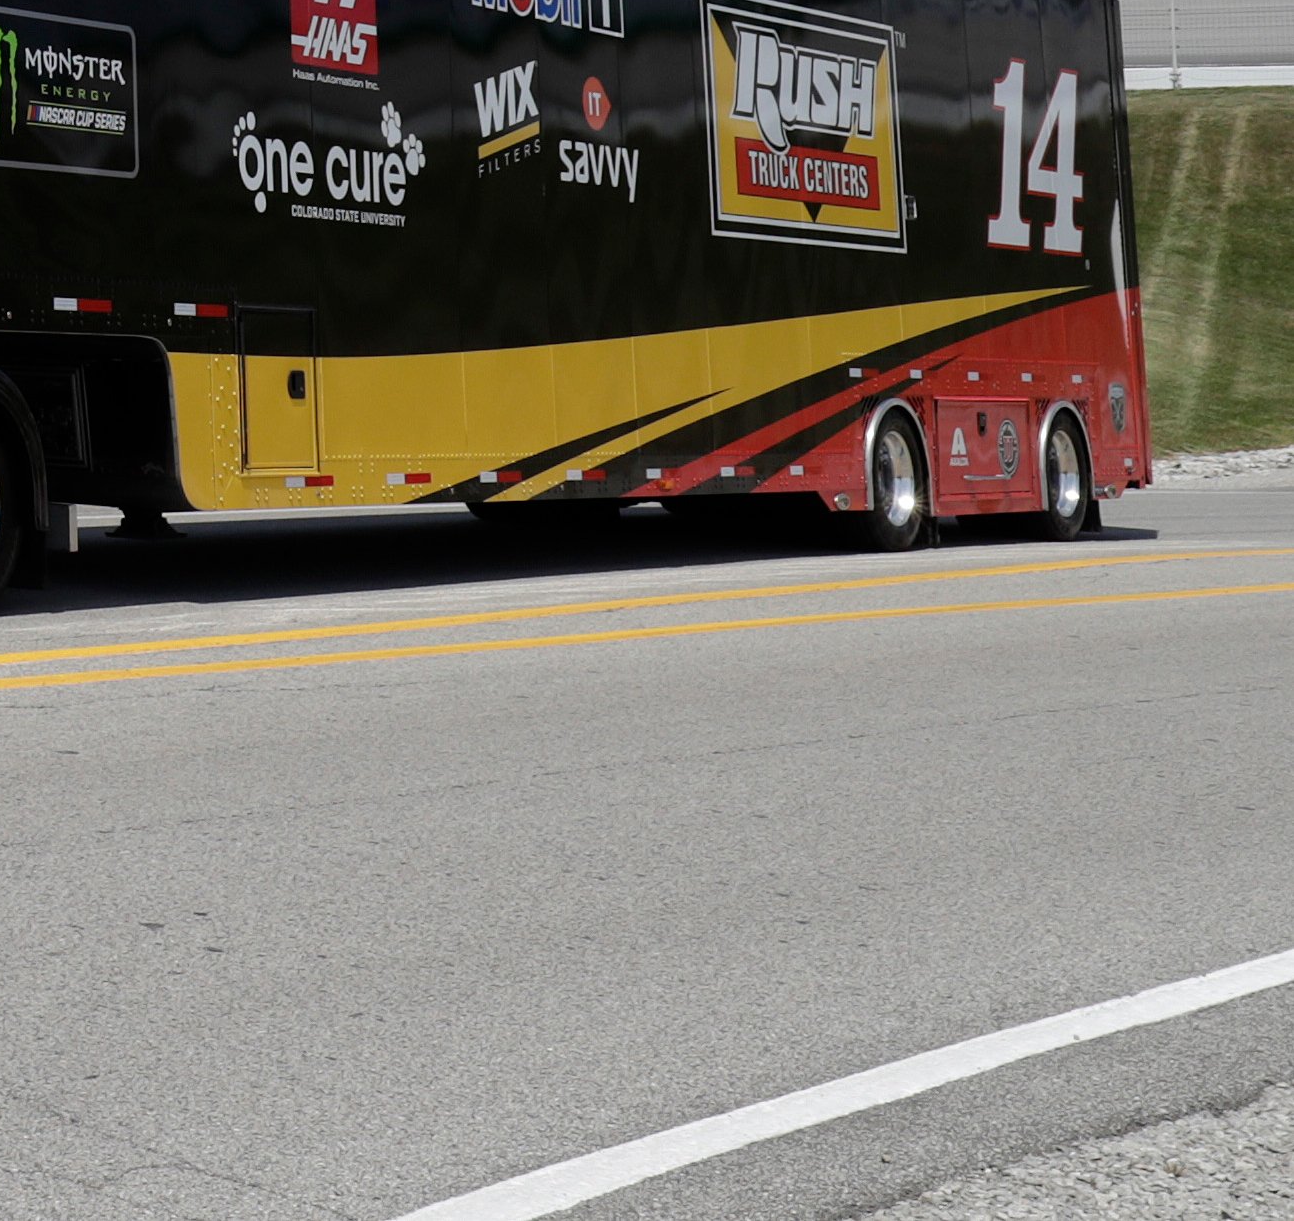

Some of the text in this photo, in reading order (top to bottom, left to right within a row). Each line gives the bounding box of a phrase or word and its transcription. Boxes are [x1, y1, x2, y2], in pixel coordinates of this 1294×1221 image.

[291, 15, 377, 65] HAAS
[25, 45, 126, 86] MONSTER
[292, 68, 380, 91] Haas Automation Inc.
[730, 21, 877, 155] RUSH
[41, 84, 111, 103] ENERGY
[474, 60, 539, 138] WIX
[588, 92, 601, 116] IT
[38, 106, 126, 131] NASCAR CUP SERIES
[239, 134, 406, 206] one cure
[478, 139, 541, 178] FILTERS
[559, 139, 639, 203] savvy
[748, 150, 868, 199] TRUCK CENTERS
[987, 57, 1084, 257] 14
[291, 204, 405, 227] COLORADO STATE UNIVERSITY
